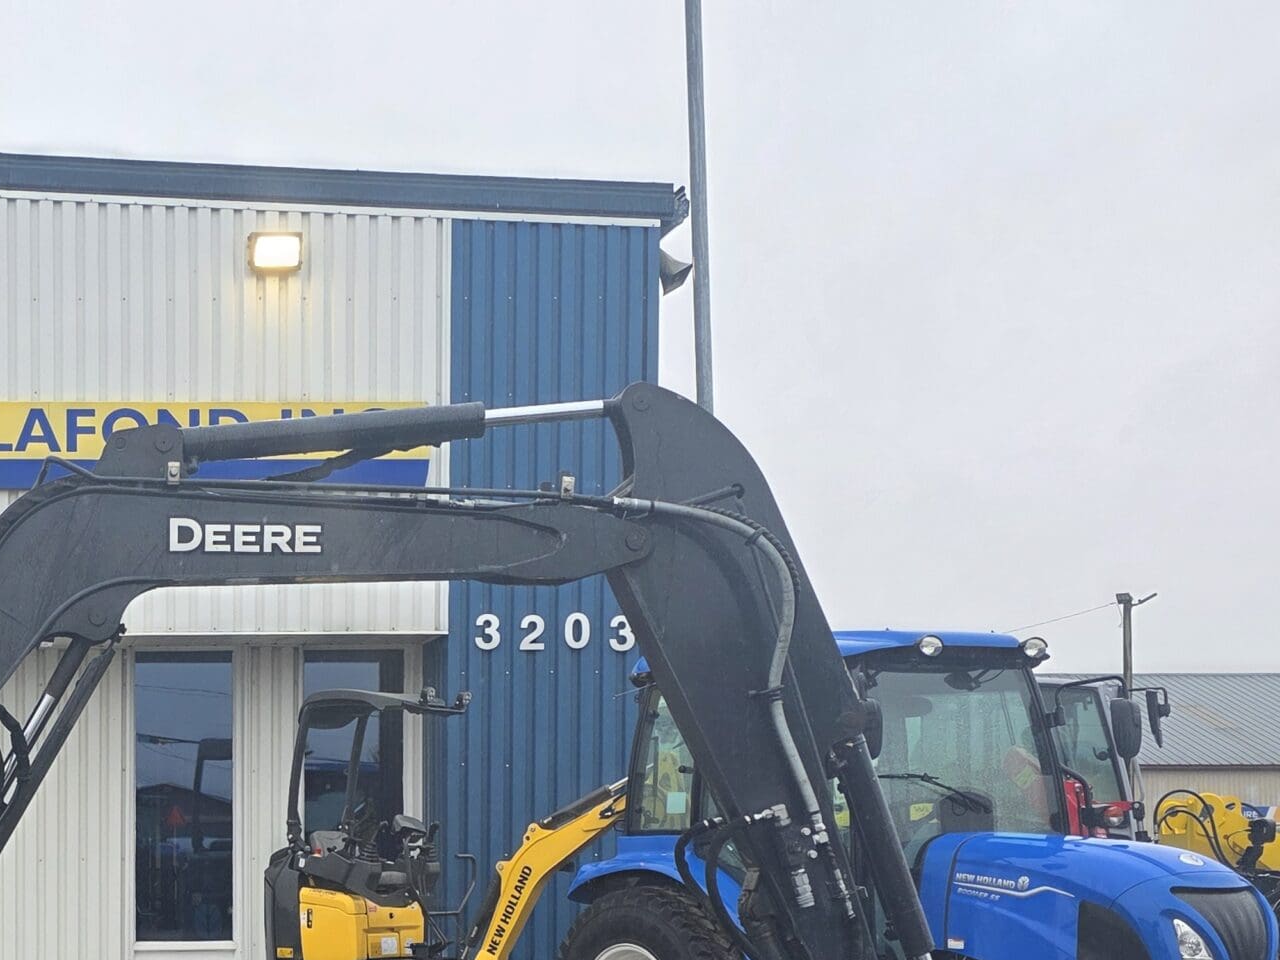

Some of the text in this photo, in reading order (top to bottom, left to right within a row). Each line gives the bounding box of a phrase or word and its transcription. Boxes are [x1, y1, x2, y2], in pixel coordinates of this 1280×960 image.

[169, 517, 322, 553] DEERE
[956, 872, 1016, 889] NEW HOLLAND
[487, 865, 532, 956] NEW HOLLAND
